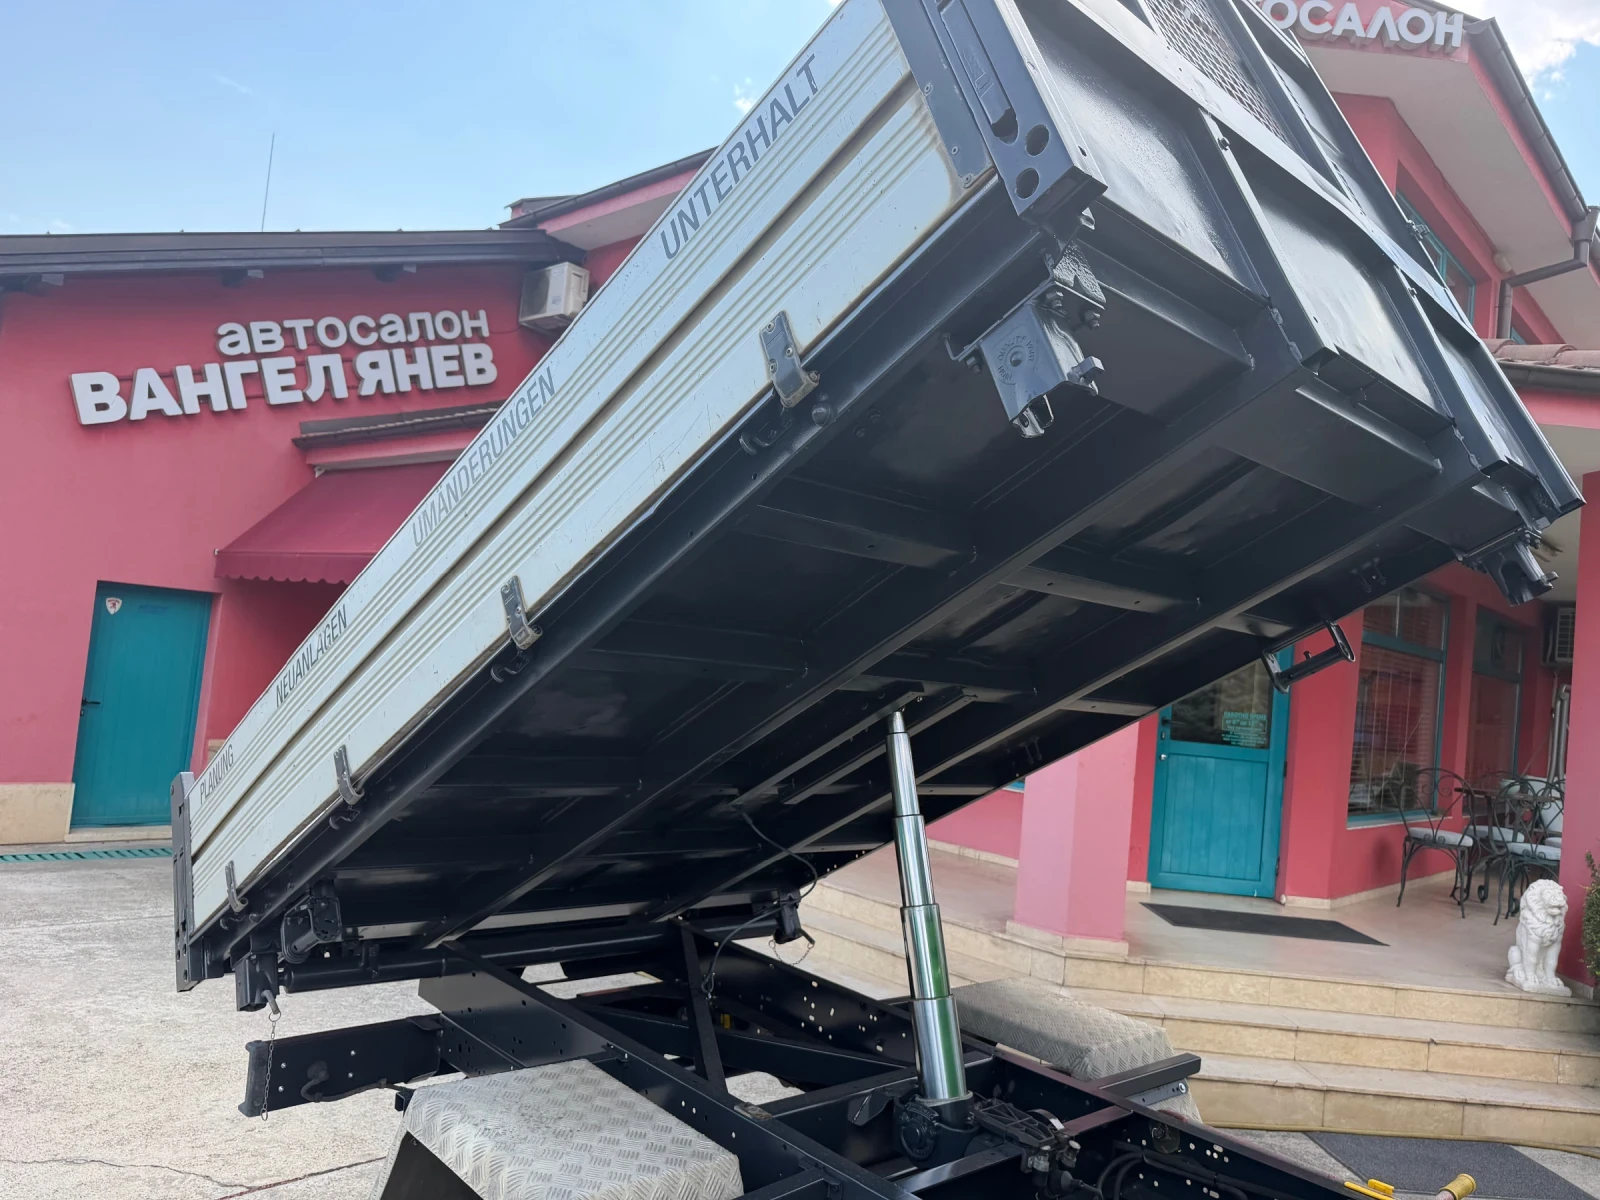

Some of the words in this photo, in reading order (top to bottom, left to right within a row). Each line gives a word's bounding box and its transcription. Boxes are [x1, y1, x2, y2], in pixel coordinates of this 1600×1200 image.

[1253, 0, 1463, 47] ОСАЛОН
[660, 54, 818, 259] UNTERHALT
[217, 310, 490, 356] автосалон
[70, 353, 349, 425] ВАНГЕЛ
[355, 343, 498, 396] ЯНЕВ
[412, 366, 556, 547] UMÄNDERUNGEN
[276, 604, 347, 708] NEUANLAGEN
[200, 744, 234, 805] PLANUNG
